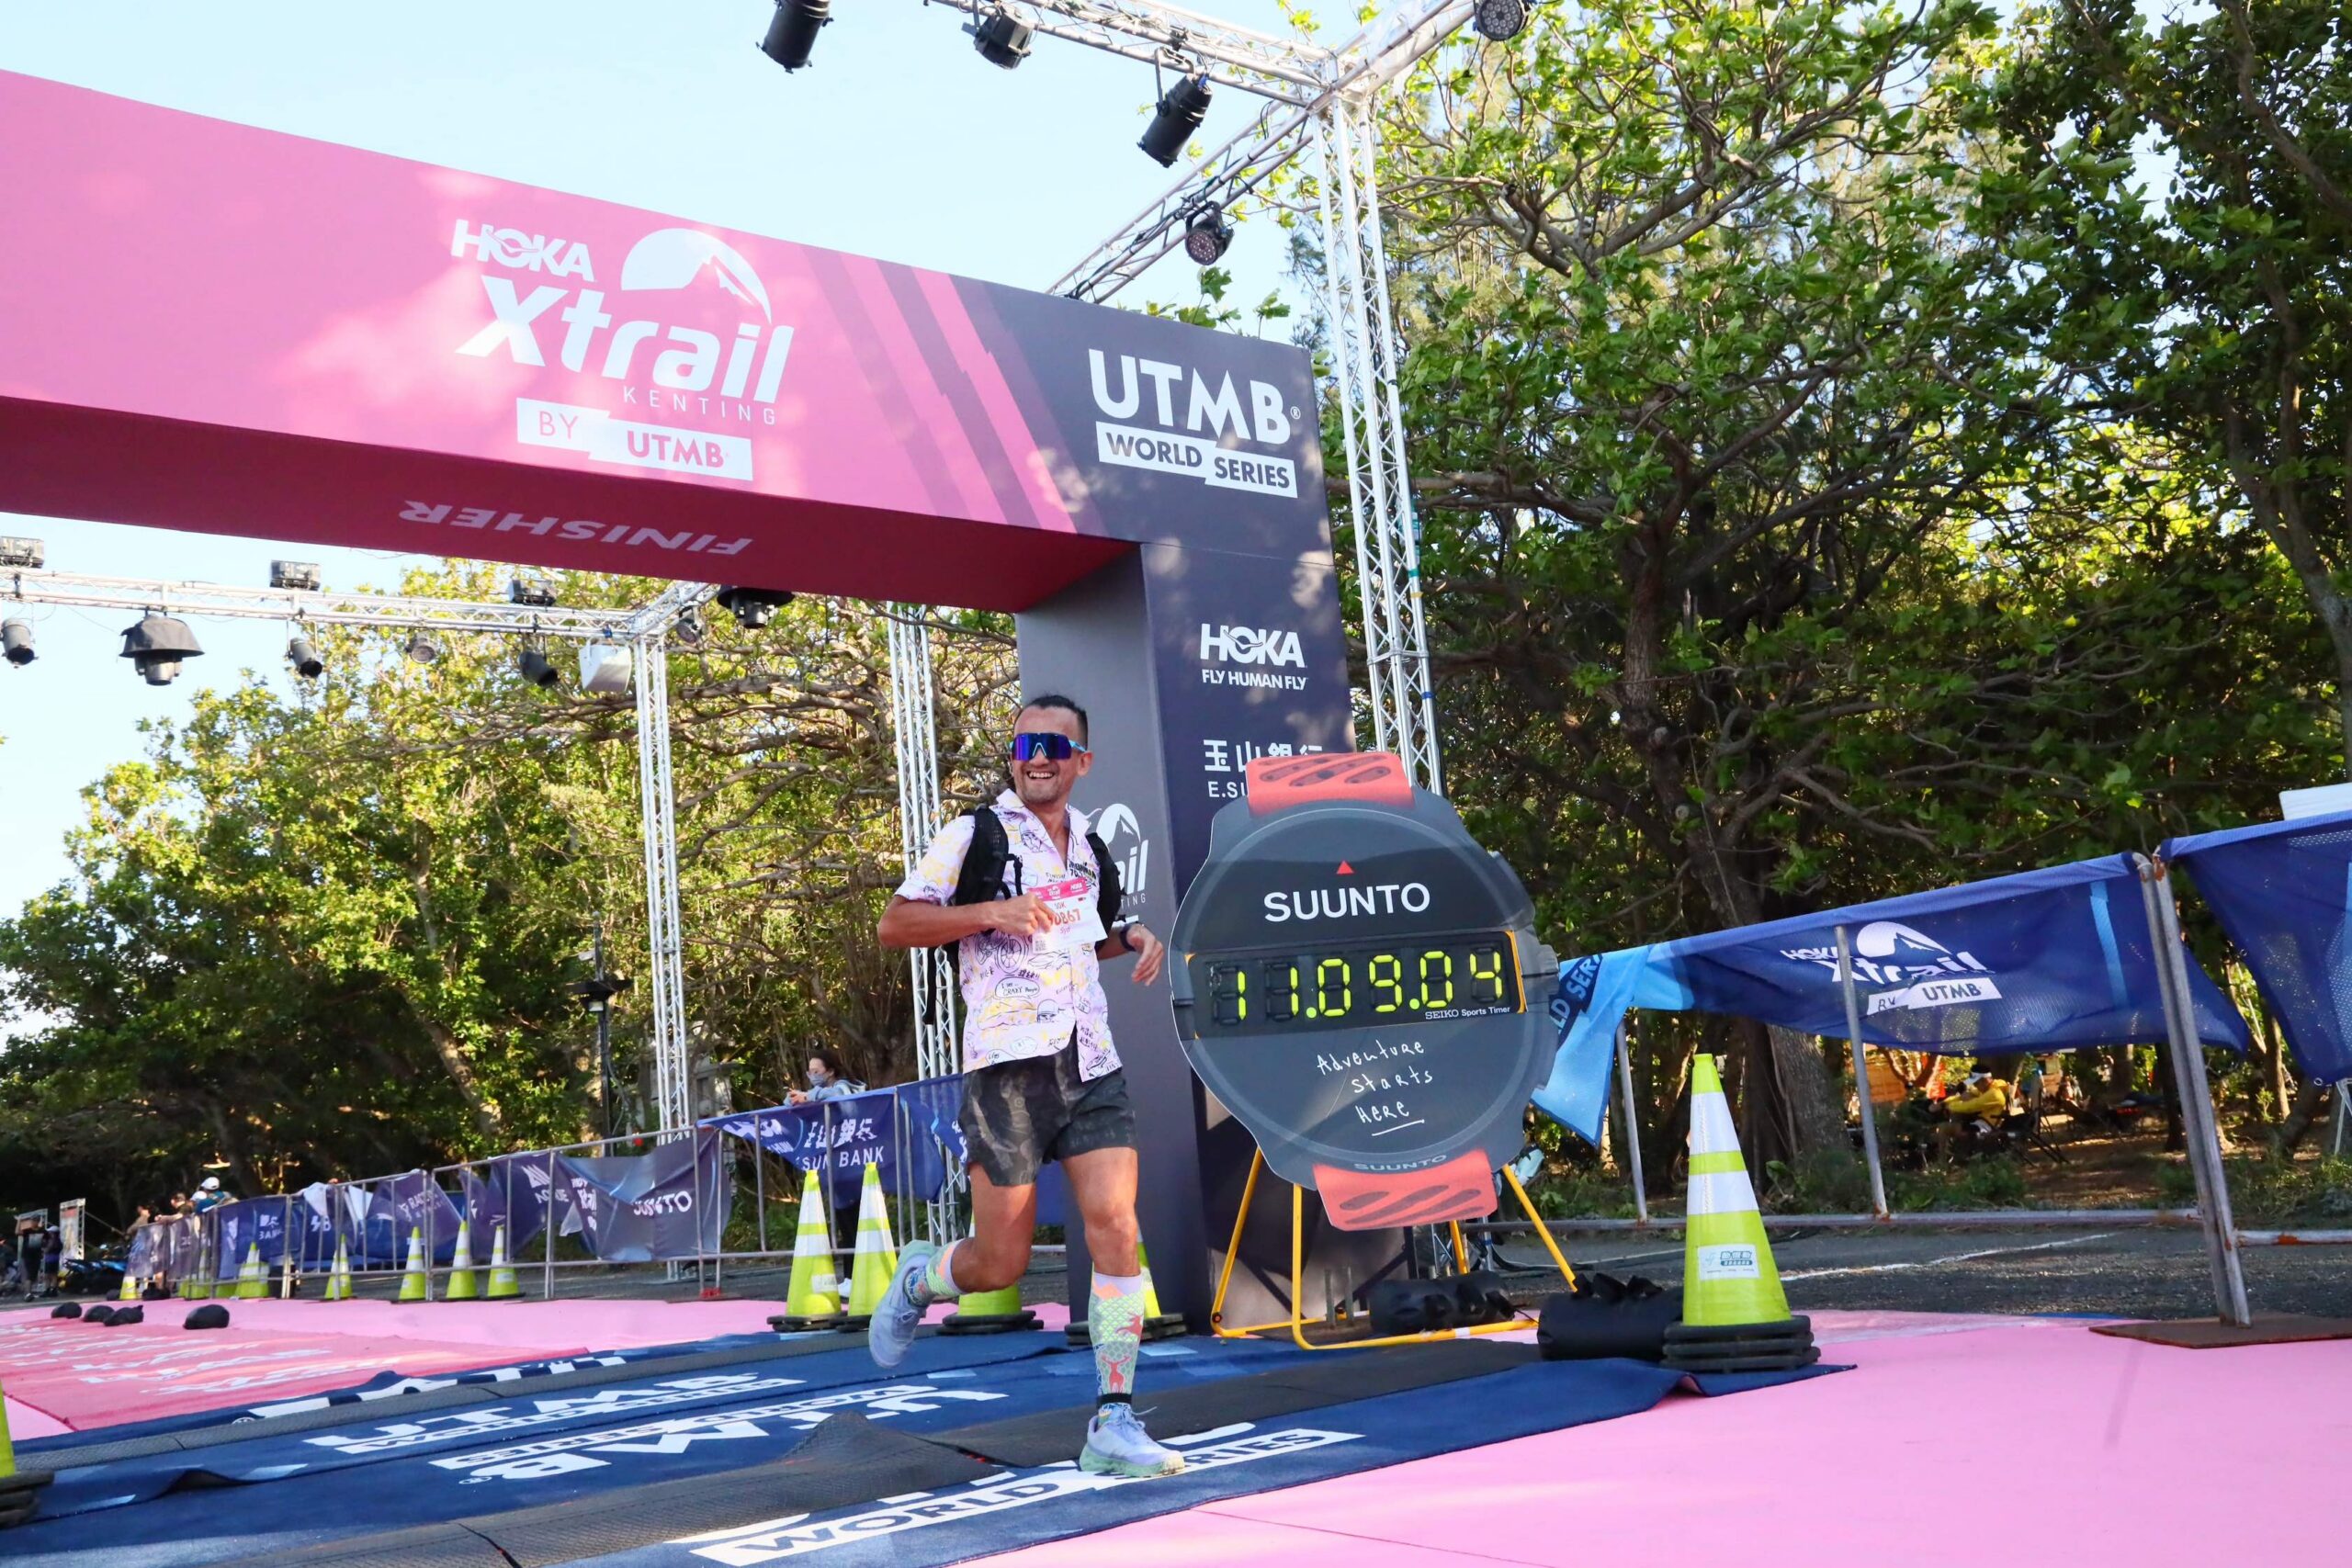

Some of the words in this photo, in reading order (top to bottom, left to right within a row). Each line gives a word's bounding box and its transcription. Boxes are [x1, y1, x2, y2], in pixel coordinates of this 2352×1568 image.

[451, 219, 594, 283] HOKA
[455, 274, 795, 404] Xtrail
[623, 386, 776, 425] KENTING
[538, 410, 580, 440] BY
[627, 429, 726, 468] UTMB
[1106, 433, 1203, 468] WORLD
[1214, 457, 1290, 490] SERIES
[399, 500, 752, 556] FINISHER
[1200, 623, 1306, 669] HOKA
[1202, 669, 1226, 684] FLY
[1228, 671, 1283, 689] HUMAN
[1284, 675, 1306, 691] FLY
[1051, 908, 1080, 926] 0867
[1263, 882, 1430, 922] SUUNTO
[1922, 983, 1982, 1002] UTMB
[1425, 1009, 1459, 1021] SEIKO
[1461, 1007, 1487, 1019] Sports
[1487, 1005, 1511, 1016] Timer
[838, 1145, 885, 1168] BANK
[1352, 1154, 1448, 1172] SUUNTO
[735, 1482, 1060, 1552] WORLD
